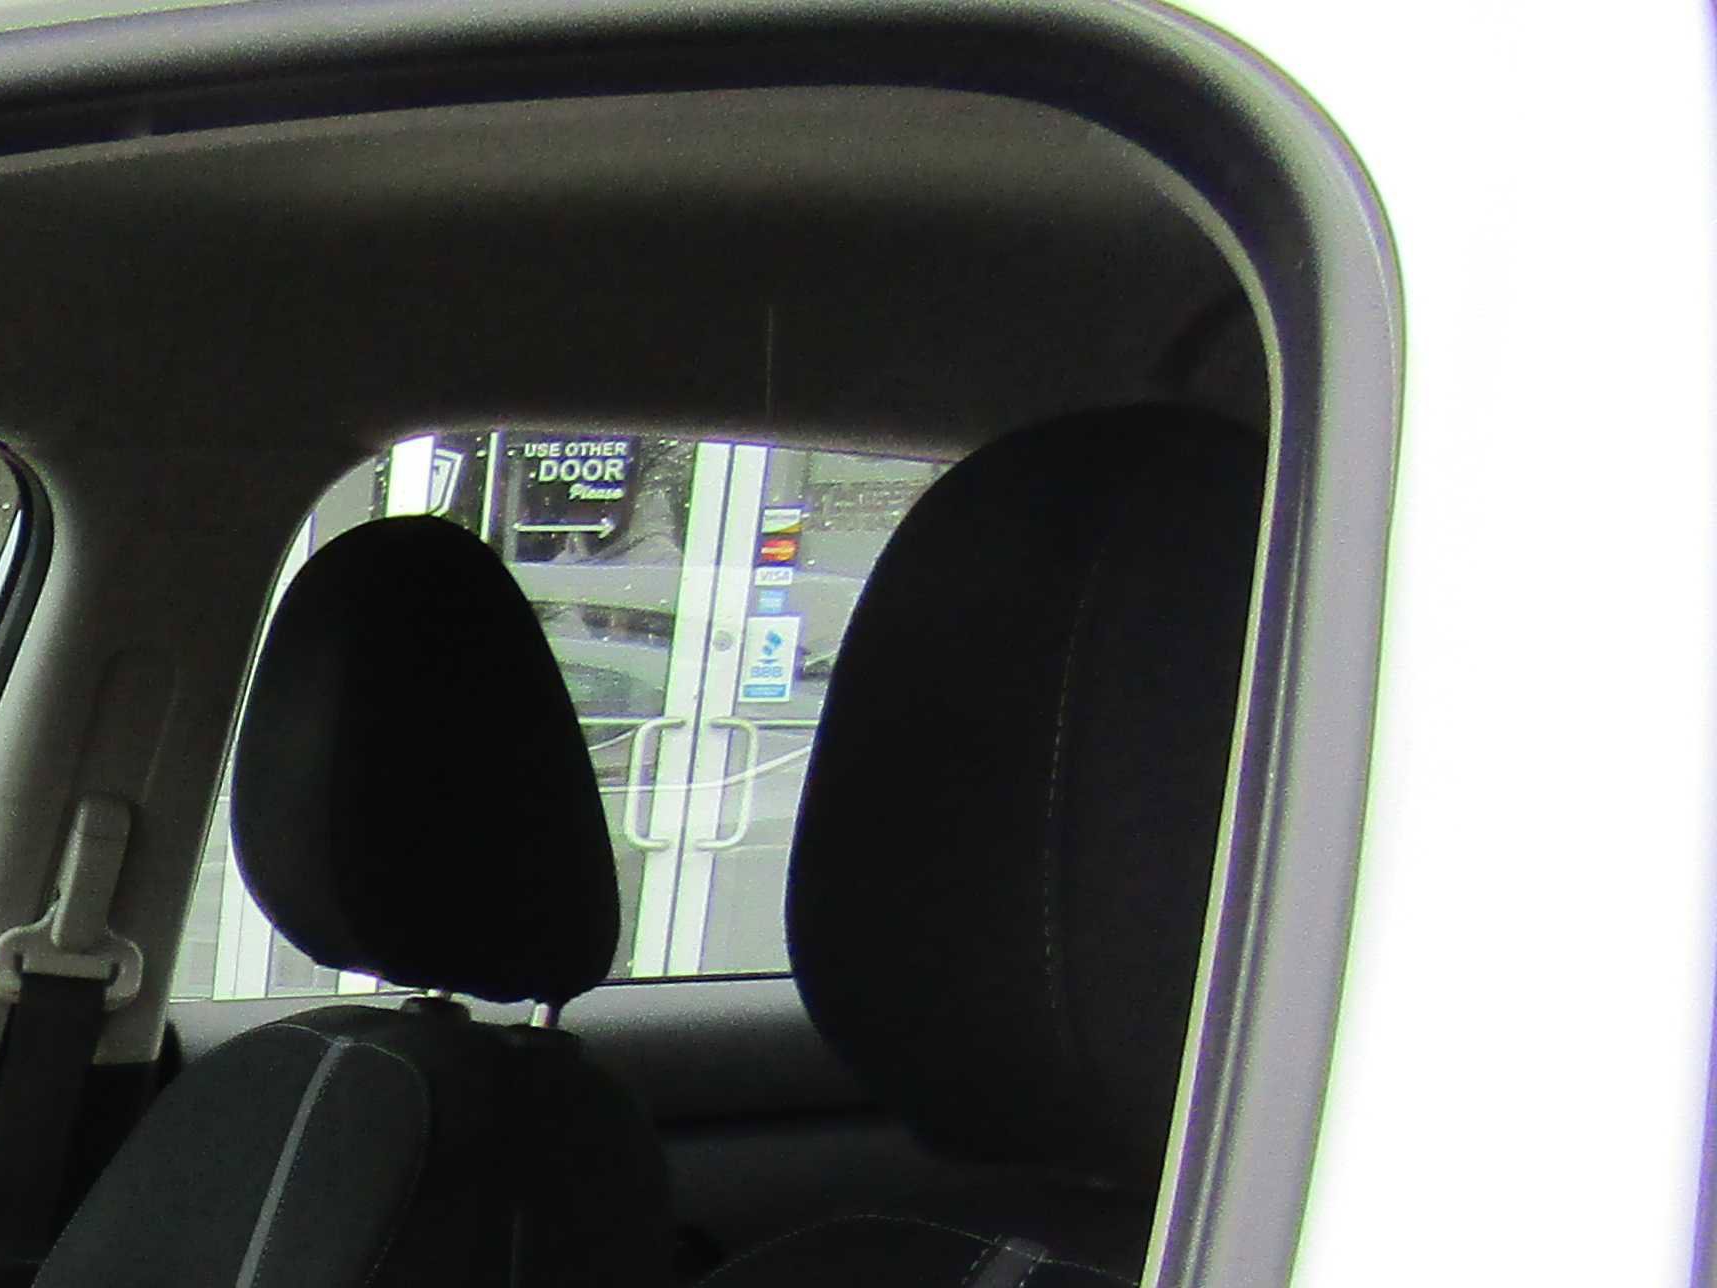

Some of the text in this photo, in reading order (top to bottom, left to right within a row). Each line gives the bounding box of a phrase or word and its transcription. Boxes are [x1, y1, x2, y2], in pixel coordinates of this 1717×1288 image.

[523, 441, 629, 457] USE OTHER
[538, 459, 626, 483] DOOR
